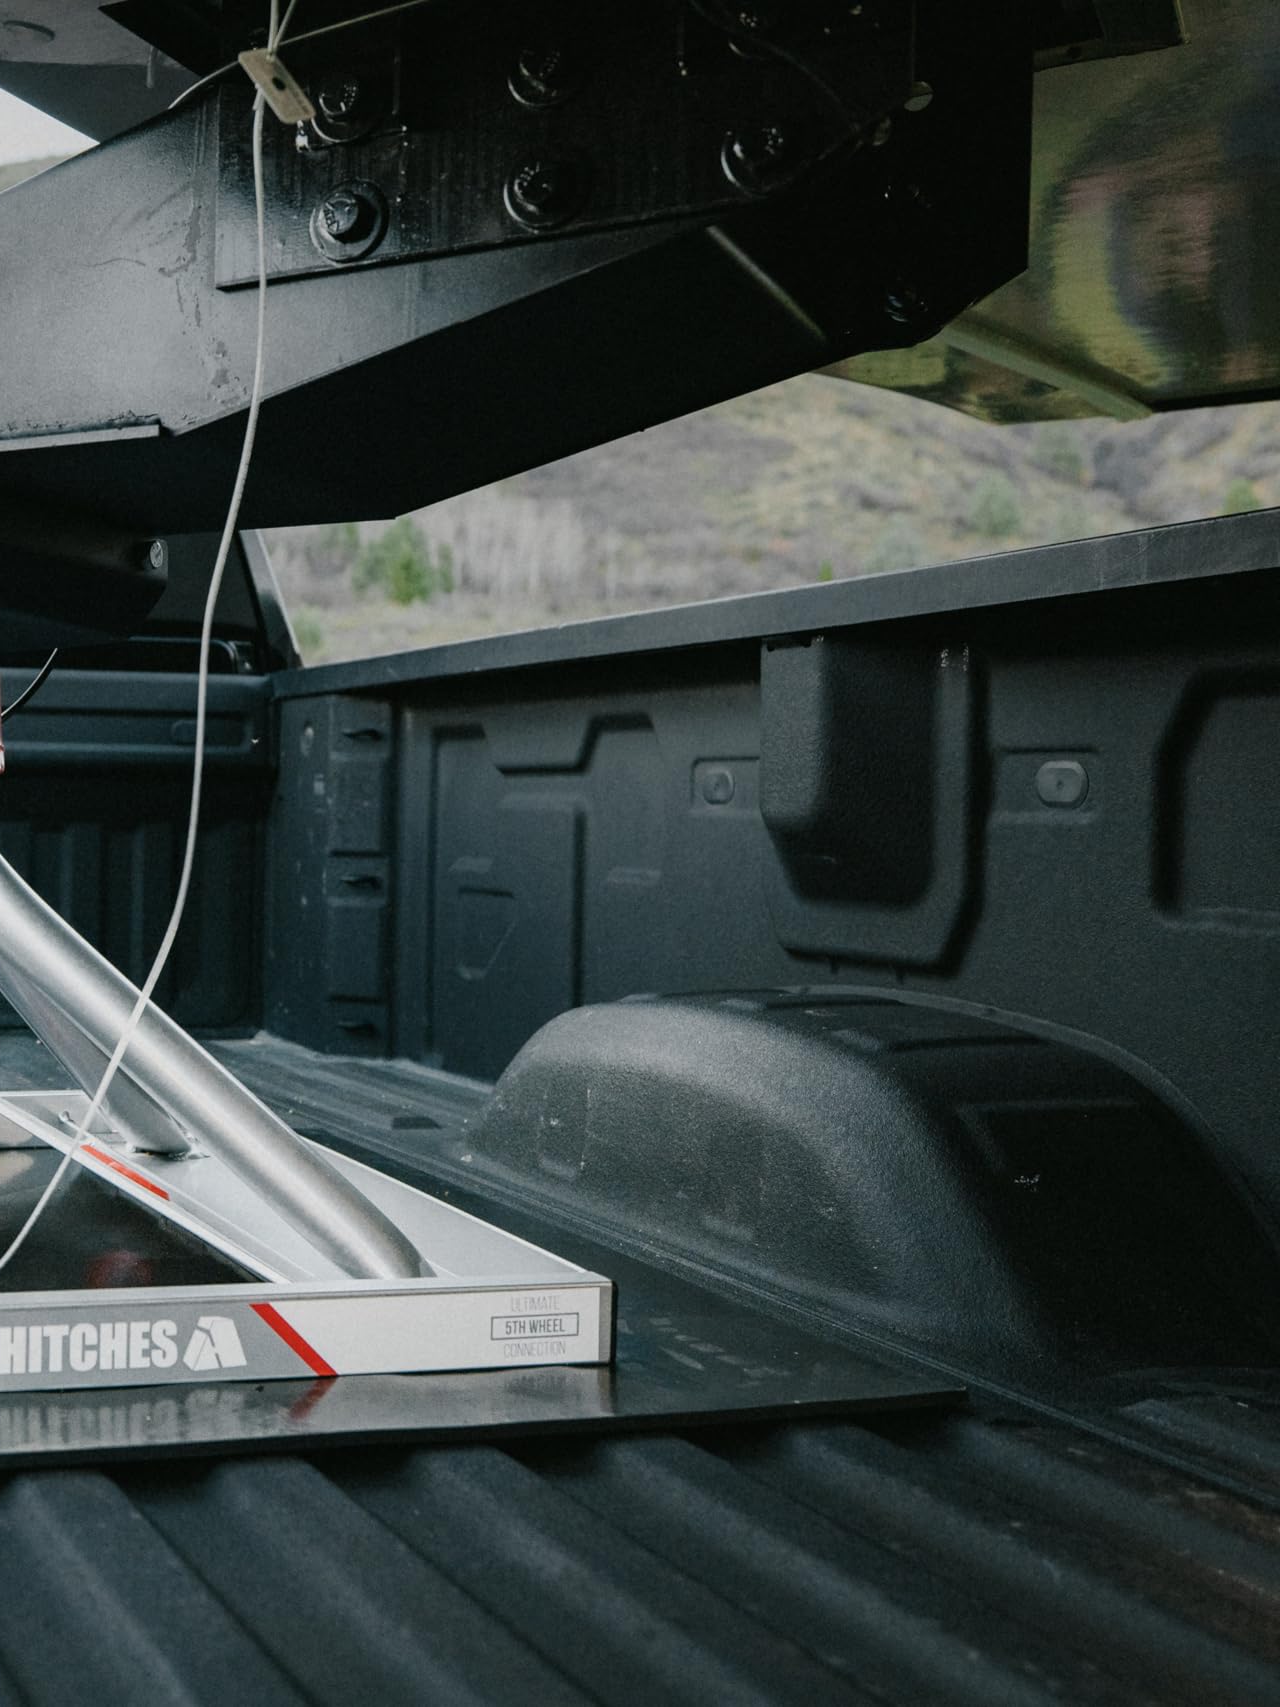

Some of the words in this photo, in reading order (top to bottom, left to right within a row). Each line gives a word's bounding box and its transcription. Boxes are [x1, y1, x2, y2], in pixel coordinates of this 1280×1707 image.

[511, 1295, 561, 1312] ULTIMATE
[505, 1320, 526, 1335] 5TH
[529, 1318, 565, 1334] WHEEL
[503, 1341, 566, 1358] CONNECTION
